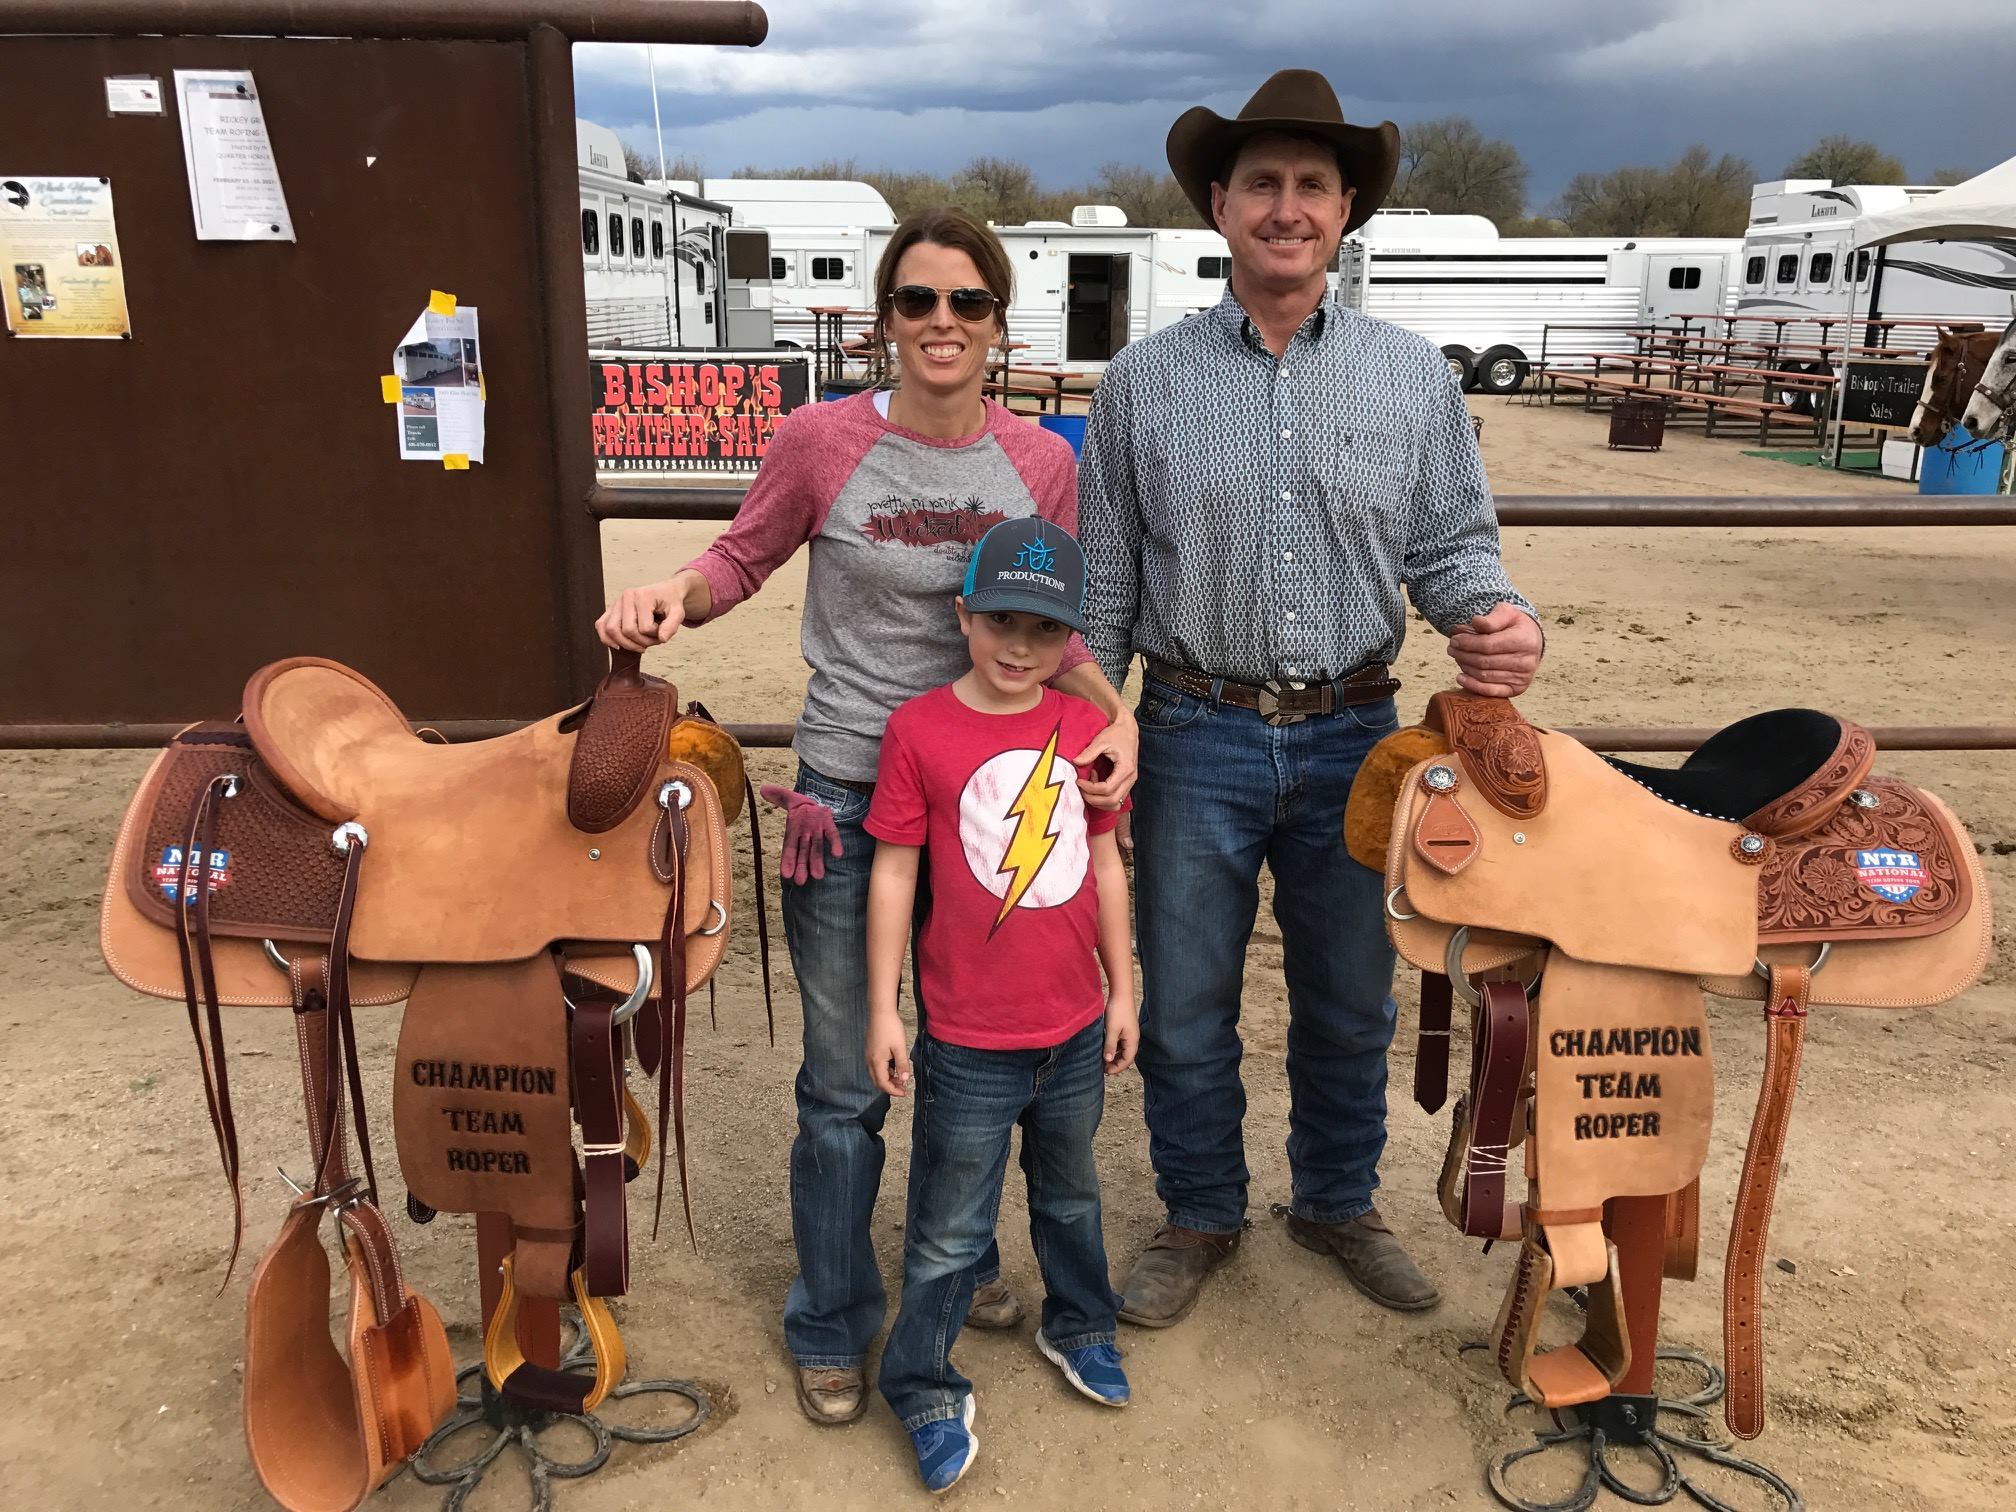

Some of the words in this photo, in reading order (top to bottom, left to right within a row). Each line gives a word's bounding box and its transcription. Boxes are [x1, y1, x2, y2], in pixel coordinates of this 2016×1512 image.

[204, 127, 227, 135] TEAM
[229, 128, 260, 136] ROPING
[601, 363, 782, 408] BISHOP'S
[1850, 374, 1885, 395] Bishop's
[1888, 376, 1920, 395] Trailer
[1870, 402, 1893, 419] Sales
[867, 494, 908, 517] pretty
[911, 498, 926, 511] in
[929, 493, 963, 518] pink
[878, 514, 966, 539] Wicked
[997, 571, 1065, 592] PRODUCTIONS
[1861, 852, 1918, 867] NTR
[1857, 867, 1926, 878] NATIONAL
[1550, 1026, 1703, 1057] CHAMPION
[411, 1058, 557, 1096] CHAMPION
[1575, 1071, 1662, 1099] TEAM
[440, 1107, 526, 1136] TEAM
[1574, 1111, 1662, 1141] ROPER
[447, 1147, 532, 1175] ROPER
